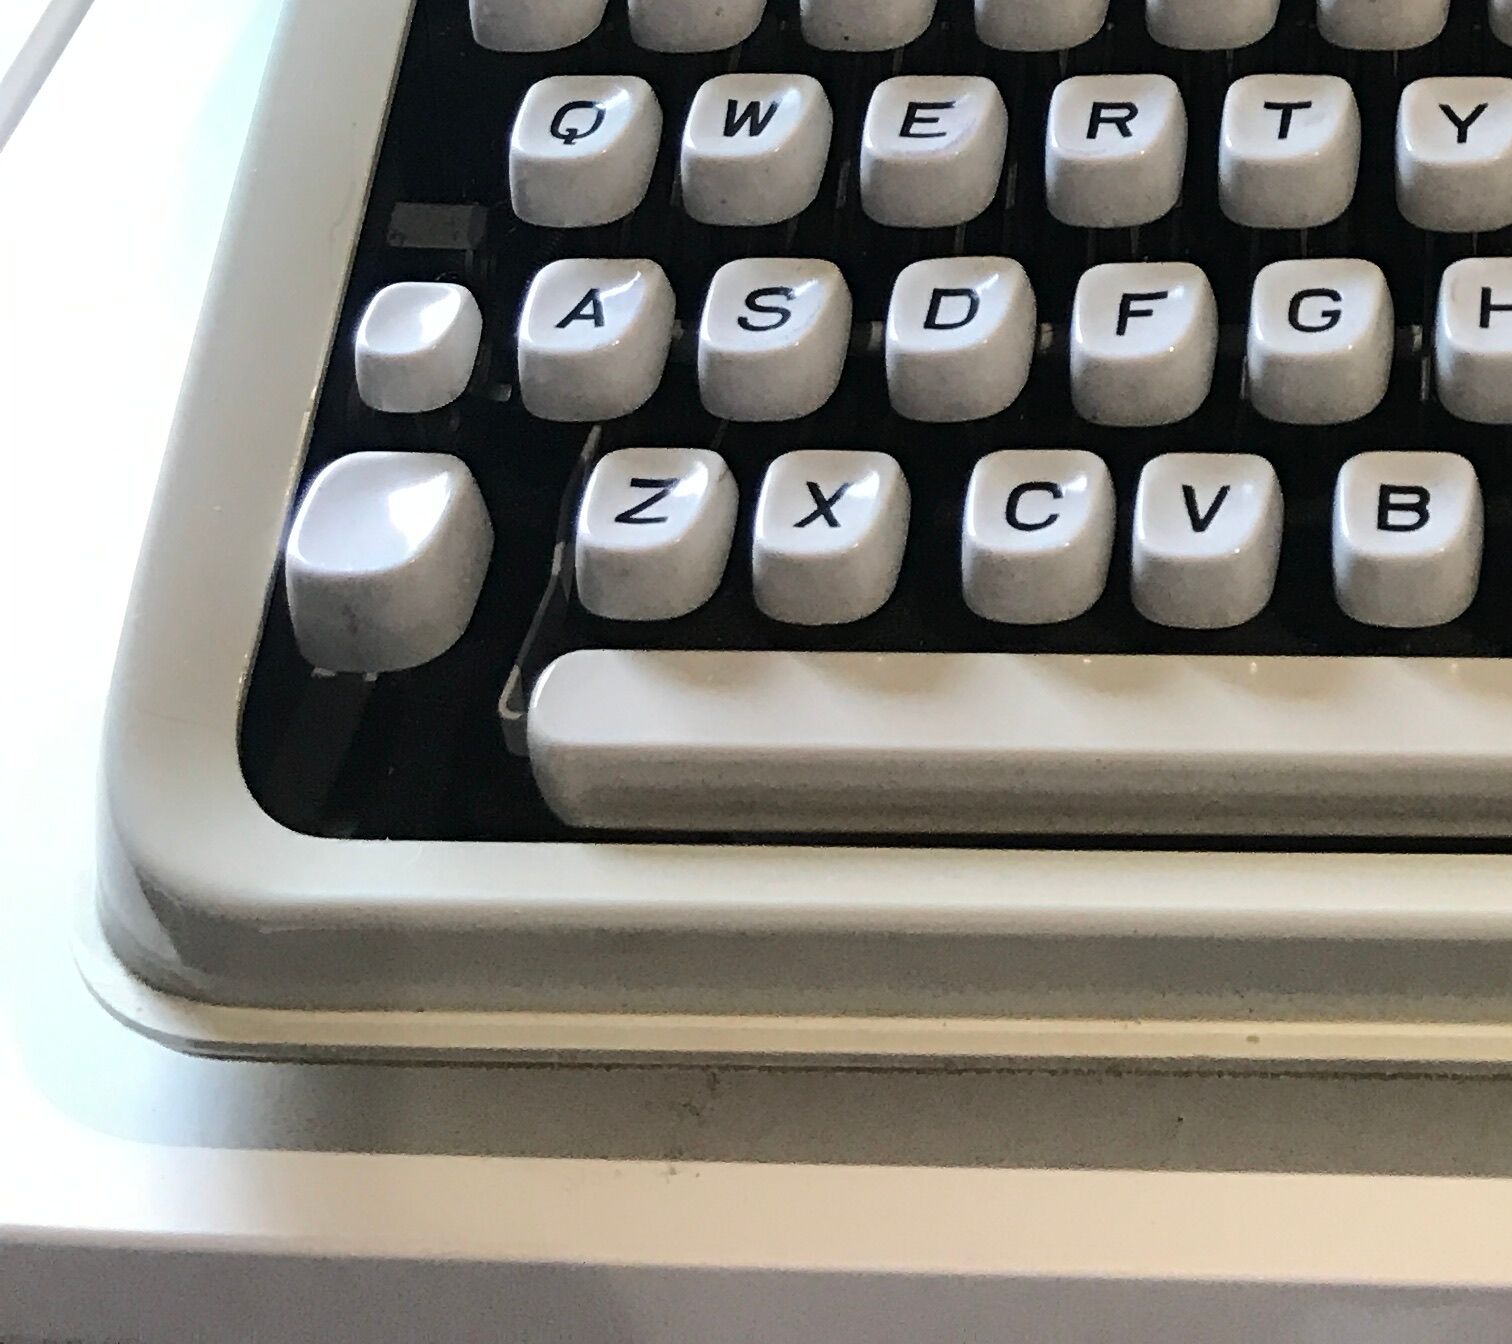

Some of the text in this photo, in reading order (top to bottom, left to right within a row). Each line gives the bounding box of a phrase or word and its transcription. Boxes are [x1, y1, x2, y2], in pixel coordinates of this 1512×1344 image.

[550, 100, 604, 145] Q
[724, 99, 778, 137] W
[898, 100, 956, 139] E
[1086, 101, 1139, 140] R
[1263, 100, 1313, 140] T
[1438, 102, 1489, 144] Y
[556, 288, 605, 328] A
[737, 287, 796, 331] S
[924, 288, 980, 330] D
[1115, 290, 1169, 337] F
[1287, 287, 1342, 333] G
[615, 478, 680, 524] Z
[794, 481, 850, 528] X
[1005, 481, 1063, 531] C
[1181, 484, 1231, 533] V
[1376, 483, 1431, 533] B
